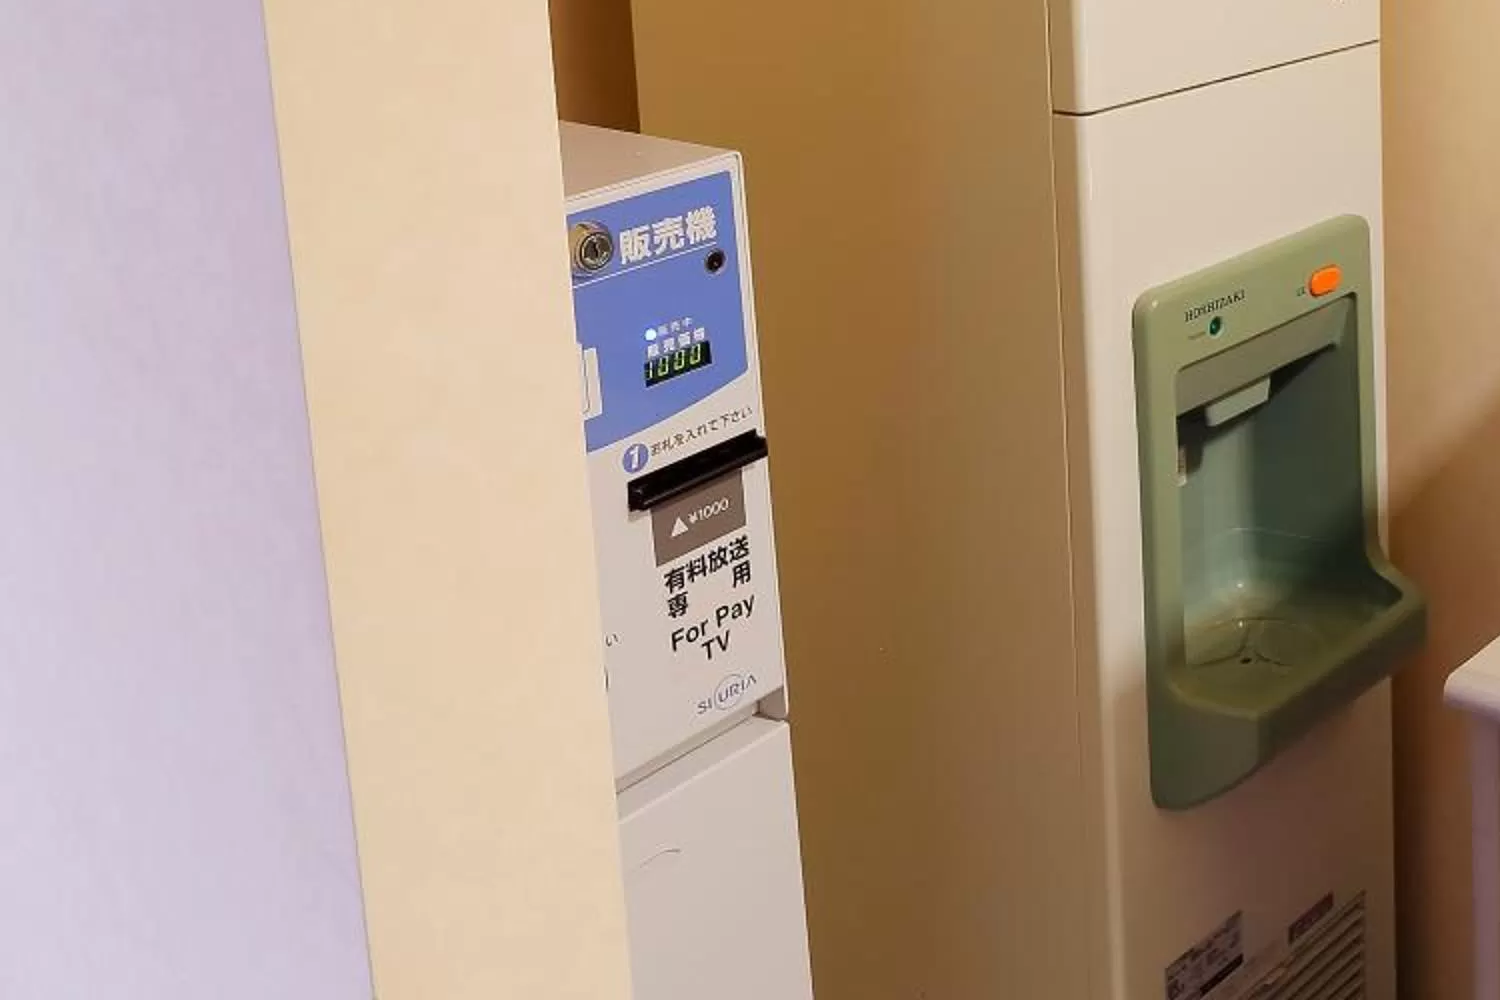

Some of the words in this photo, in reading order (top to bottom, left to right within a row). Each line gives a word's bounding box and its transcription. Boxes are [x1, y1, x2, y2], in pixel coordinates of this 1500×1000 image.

[618, 204, 718, 265] 販売機
[648, 343, 701, 380] 1000
[687, 497, 730, 525] ¥1000
[663, 535, 751, 594] 有料放送
[733, 560, 752, 589] 用
[671, 618, 709, 653] For
[715, 594, 755, 629] Pay
[701, 629, 731, 661] TV
